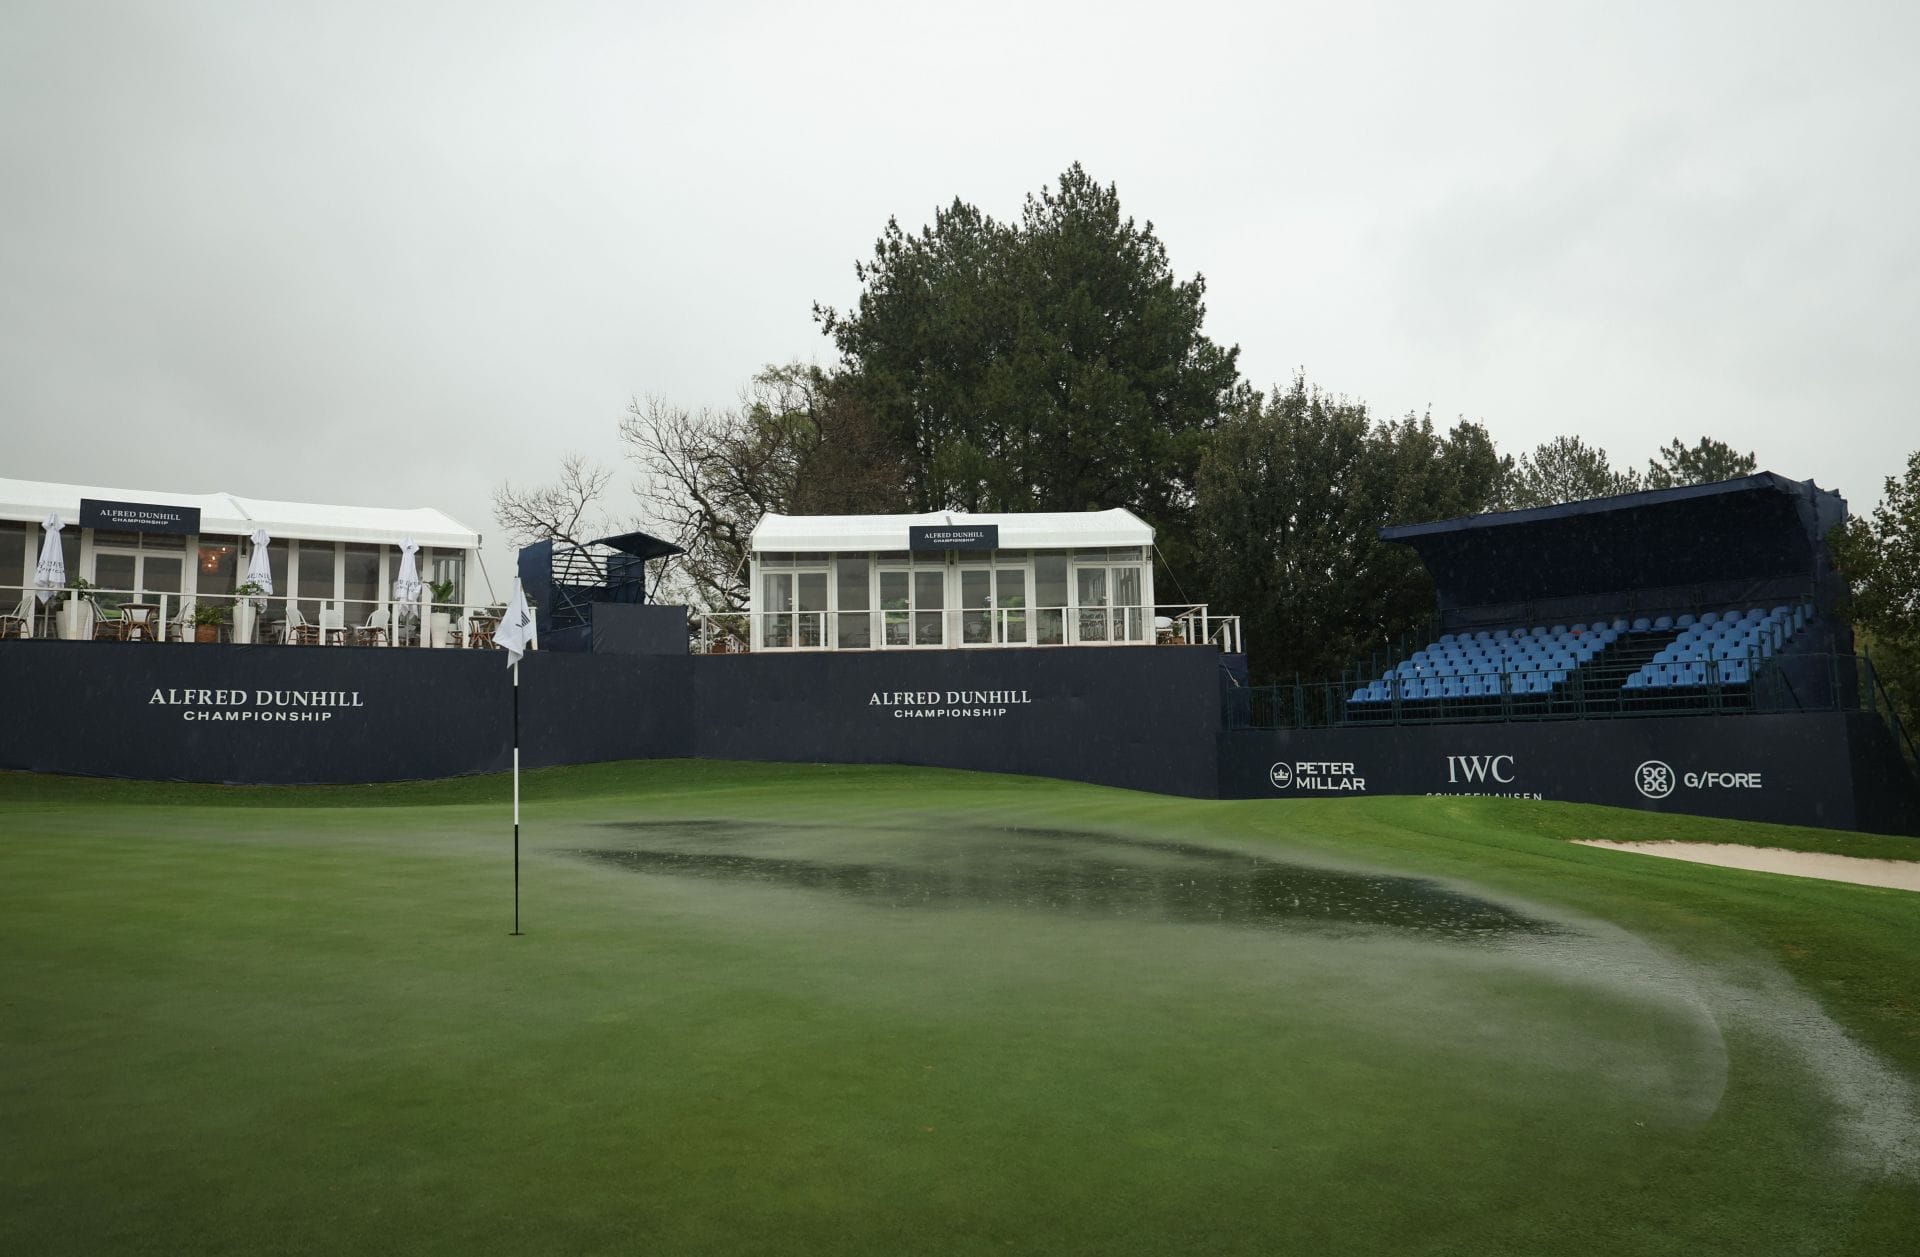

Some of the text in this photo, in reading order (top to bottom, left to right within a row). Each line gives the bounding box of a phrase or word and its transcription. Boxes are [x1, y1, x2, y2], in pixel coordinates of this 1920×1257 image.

[99, 509, 181, 521] ALFRED DUNHILL
[112, 517, 169, 525] CHAMPIONSHIP
[149, 688, 364, 707] ALFRED DUNHILL
[869, 690, 1032, 705] ALFRED DUNHILL
[183, 711, 332, 721] CHAMPIONSHIP
[894, 708, 1007, 718] CHAMPIONSHIP
[1296, 762, 1355, 775] PETER
[1446, 754, 1515, 783] IWC
[1296, 777, 1366, 790] MILLAR
[1683, 771, 1762, 789] G/FORE
